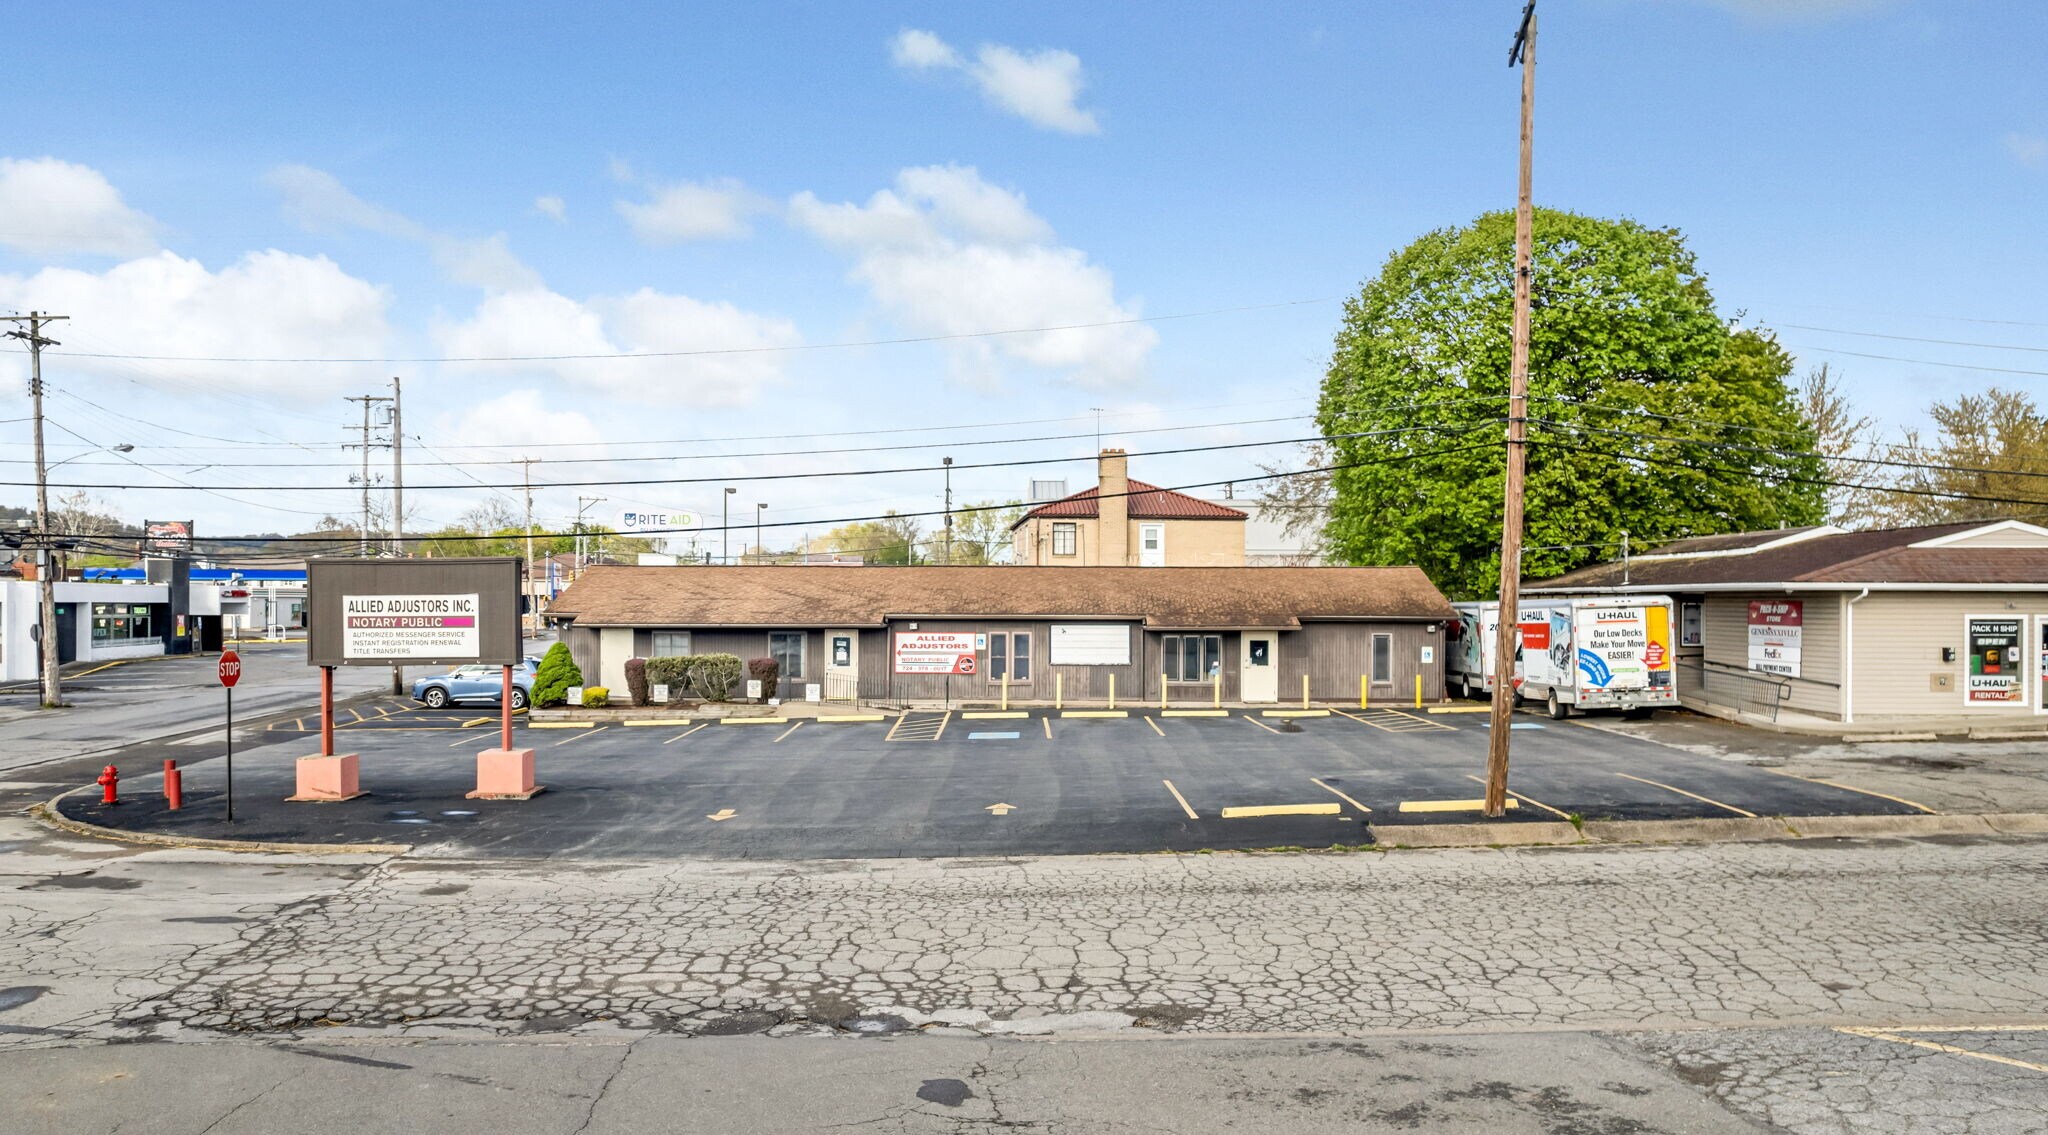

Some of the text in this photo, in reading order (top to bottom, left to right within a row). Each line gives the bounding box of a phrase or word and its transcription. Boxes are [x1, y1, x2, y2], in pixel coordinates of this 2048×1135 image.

[639, 514, 691, 525] RITE AID
[348, 599, 474, 613] ALLIED ADJUSTORS INC.
[1521, 611, 1544, 620] U-HAUL
[1597, 612, 1637, 620] U-HAUL
[1766, 615, 1782, 623] STORE
[352, 617, 443, 627] NOTARY PUBLIC
[1593, 629, 1643, 638] Our Low Decks
[1590, 640, 1645, 649] Make Your Move
[1607, 651, 1635, 660] EASIER!
[1764, 648, 1782, 659] FedEx
[220, 662, 240, 677] STOP
[1763, 664, 1779, 672] PAYMENT
[1779, 665, 1792, 673] CENTER
